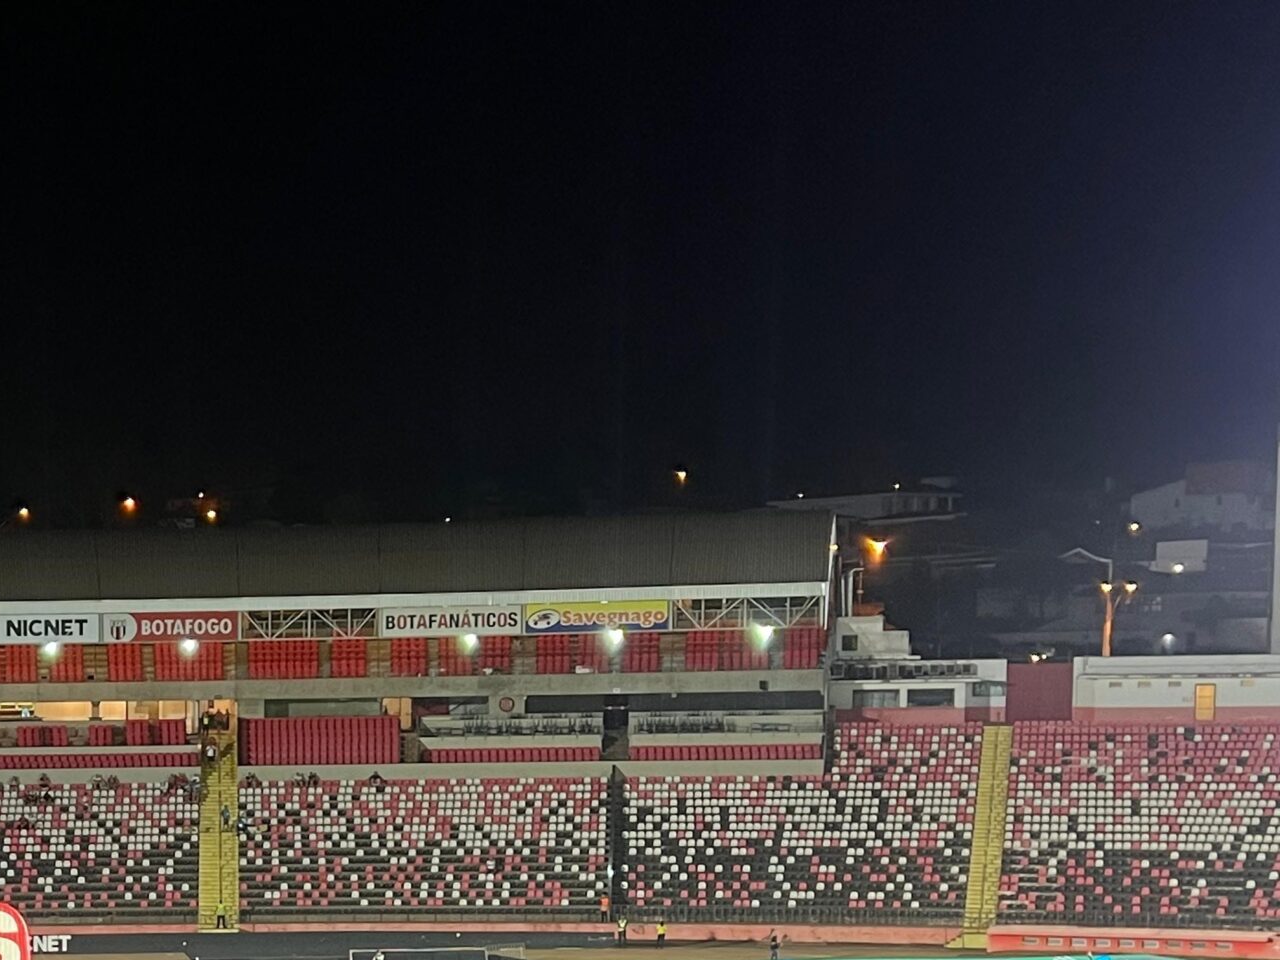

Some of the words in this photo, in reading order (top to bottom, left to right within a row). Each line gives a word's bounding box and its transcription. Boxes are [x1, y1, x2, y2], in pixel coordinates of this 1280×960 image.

[6, 618, 89, 637] NICNET
[141, 618, 233, 636] BOTAFOGO
[385, 609, 519, 631] BOTAFANÁTICOS
[559, 609, 667, 629] Savegnago
